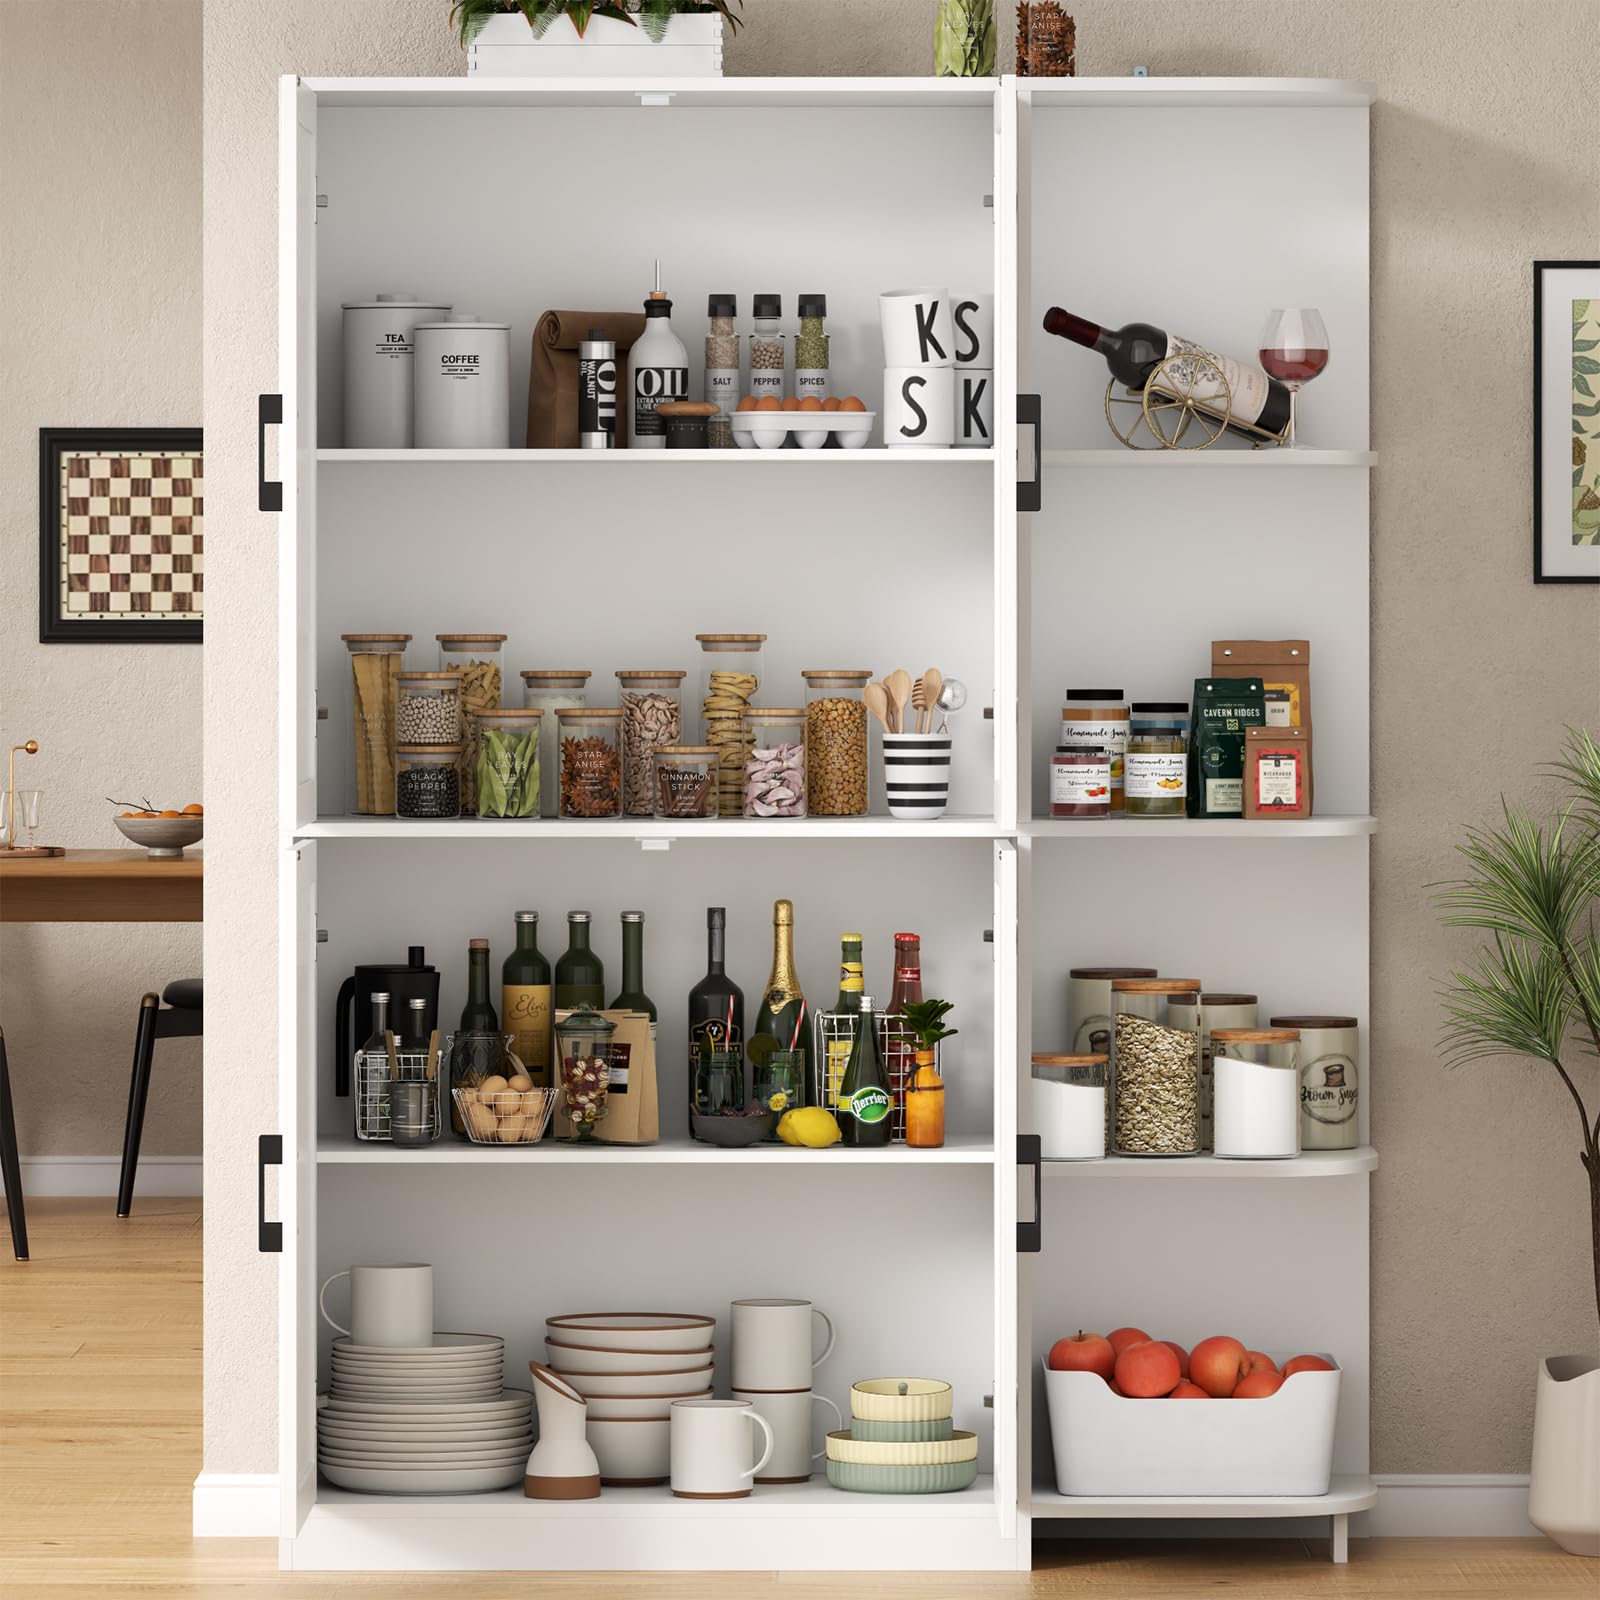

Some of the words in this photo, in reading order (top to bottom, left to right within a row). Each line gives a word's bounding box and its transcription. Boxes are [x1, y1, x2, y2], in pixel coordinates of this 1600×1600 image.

[1034, 12, 1060, 20] STAR
[1031, 22, 1062, 30] ANISE
[915, 300, 947, 363] K
[954, 301, 980, 362] S
[384, 333, 405, 343] TEA
[441, 355, 480, 364] COFFEE
[586, 360, 596, 400] WALNUT
[636, 368, 688, 397] OIL
[712, 377, 731, 386] SALT
[753, 377, 781, 386] PEPPER
[799, 377, 825, 386] SPICES
[597, 361, 617, 431] OIL
[900, 375, 928, 438] S
[963, 378, 989, 438] K
[1203, 708, 1232, 718] CAVERN
[1234, 708, 1260, 717] RIDGES
[498, 751, 517, 759] BAY
[577, 751, 602, 759] STAR
[489, 760, 526, 769] LEAVES
[575, 760, 605, 769] ANISE
[411, 773, 444, 781] BLACK
[661, 773, 711, 782] CINNAMON
[408, 782, 447, 791] PEPPER
[671, 783, 700, 791] STICK
[1301, 1086, 1335, 1103] Brown
